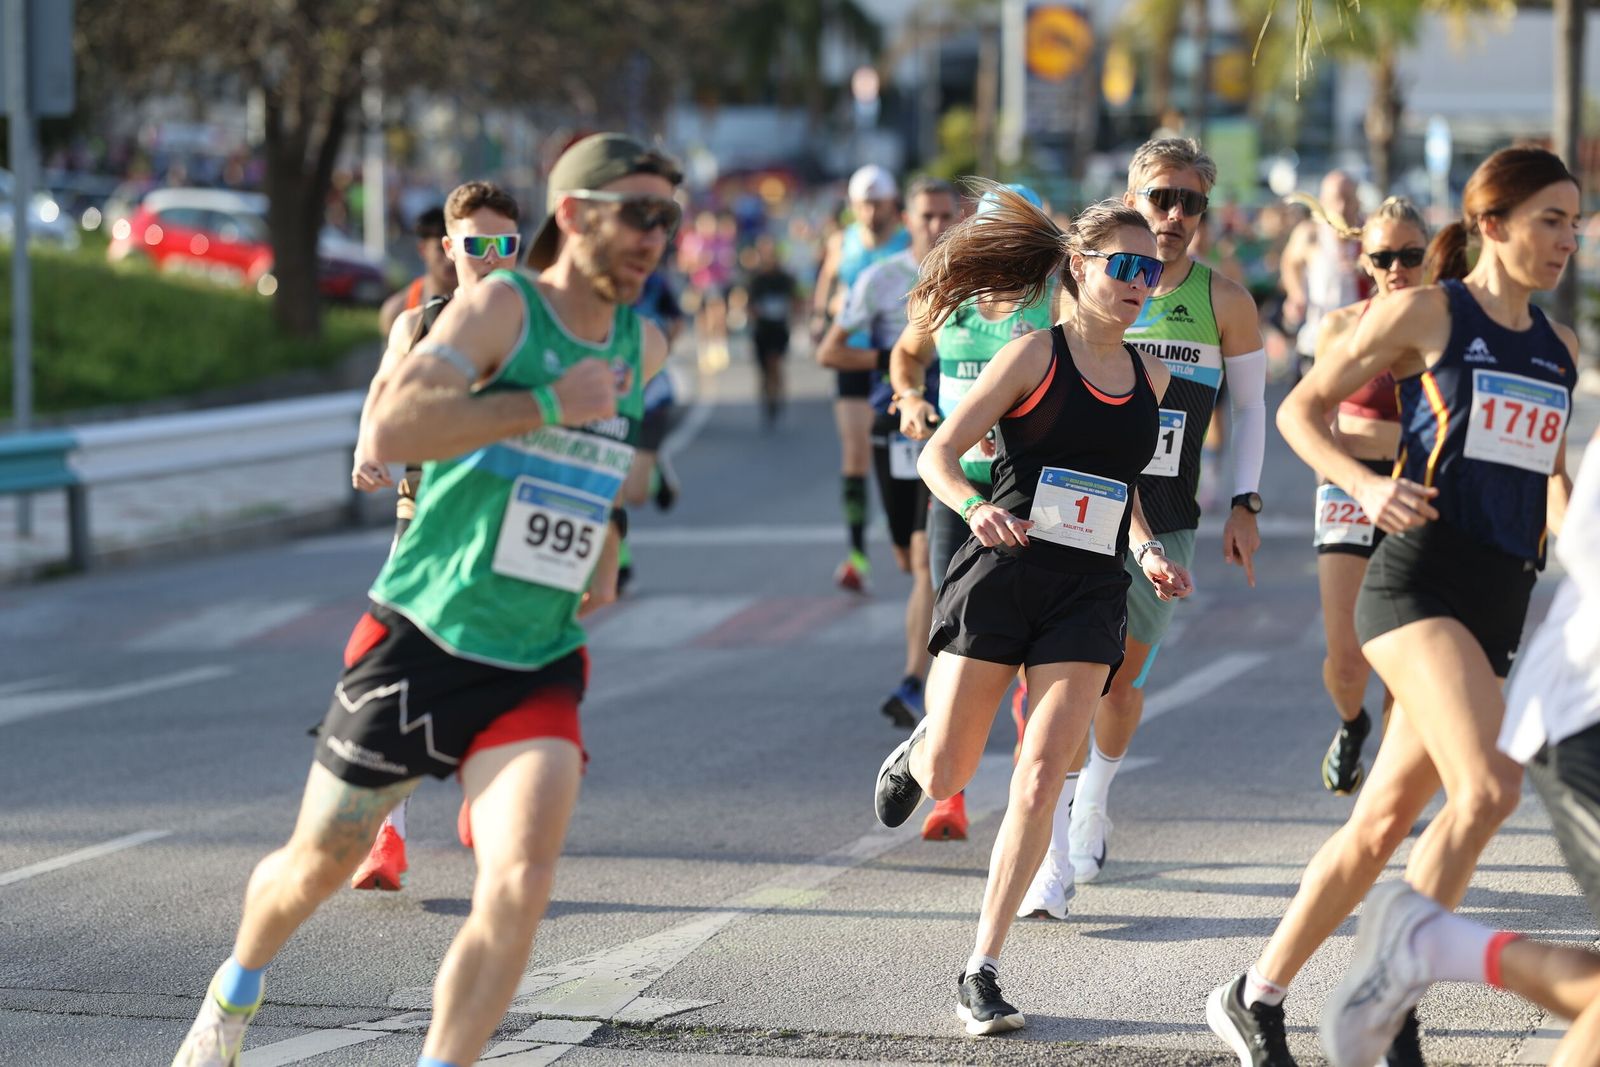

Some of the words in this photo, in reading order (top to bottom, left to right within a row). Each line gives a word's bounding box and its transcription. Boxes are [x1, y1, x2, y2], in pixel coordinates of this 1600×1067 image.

[1481, 397, 1561, 444] 1718
[1075, 495, 1090, 524] 1
[525, 511, 595, 560] 995
